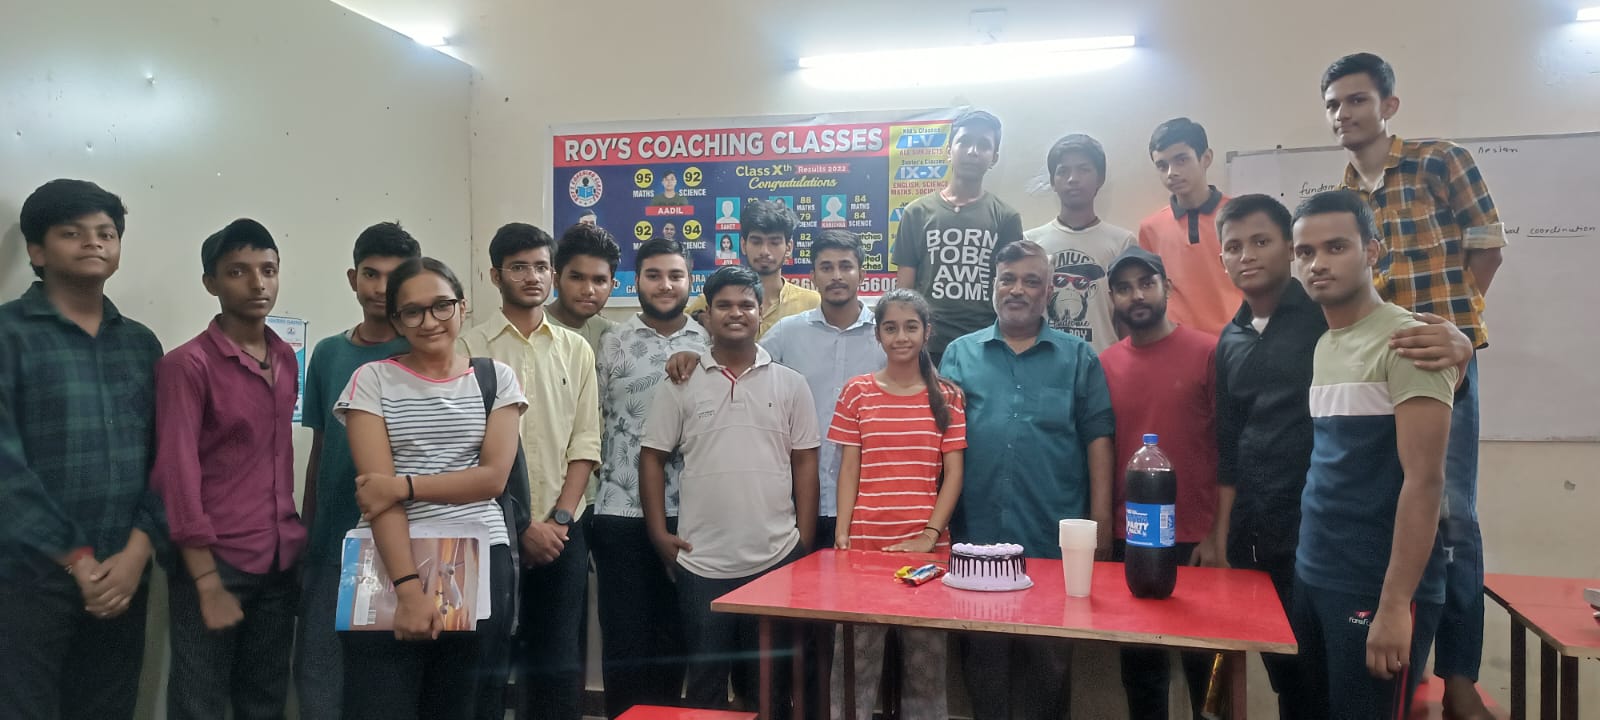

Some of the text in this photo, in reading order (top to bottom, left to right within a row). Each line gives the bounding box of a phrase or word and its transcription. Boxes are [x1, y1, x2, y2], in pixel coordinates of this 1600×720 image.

[564, 128, 883, 162] ROY'S COACHING CLASSES
[684, 171, 701, 183] 92
[735, 165, 771, 177] Class
[798, 165, 826, 173] Results
[636, 173, 652, 184] 95
[748, 175, 838, 192] Congratulations
[632, 189, 655, 198] MATHS
[678, 188, 707, 197] SCIENCE
[657, 207, 684, 215] AADIL
[635, 225, 652, 236] 92
[684, 224, 701, 235] 94
[926, 228, 999, 250] BORN
[934, 265, 991, 283] AWE
[931, 281, 990, 301] SOME
